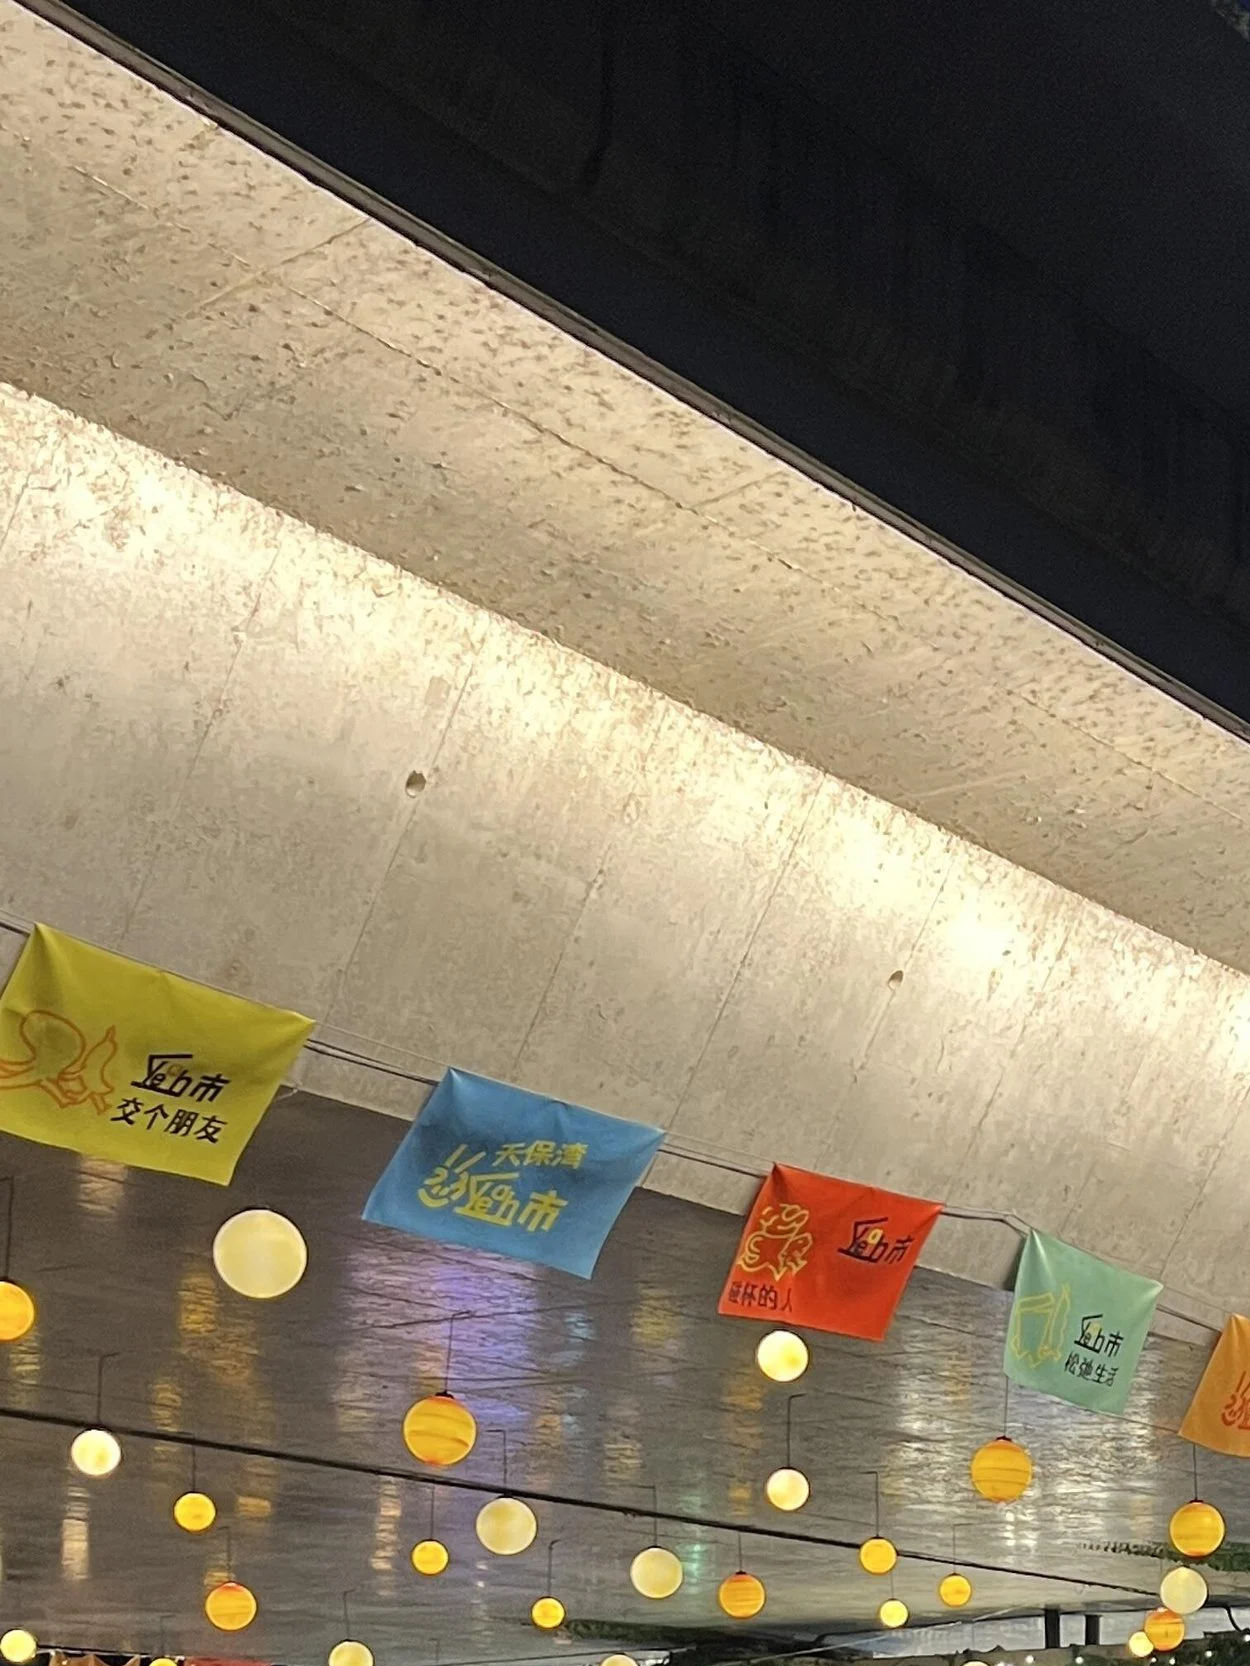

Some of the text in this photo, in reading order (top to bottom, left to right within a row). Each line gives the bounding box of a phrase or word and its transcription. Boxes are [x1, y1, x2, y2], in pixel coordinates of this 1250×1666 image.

[110, 1097, 228, 1143] 交个朋友
[491, 1139, 588, 1169] 天保湾
